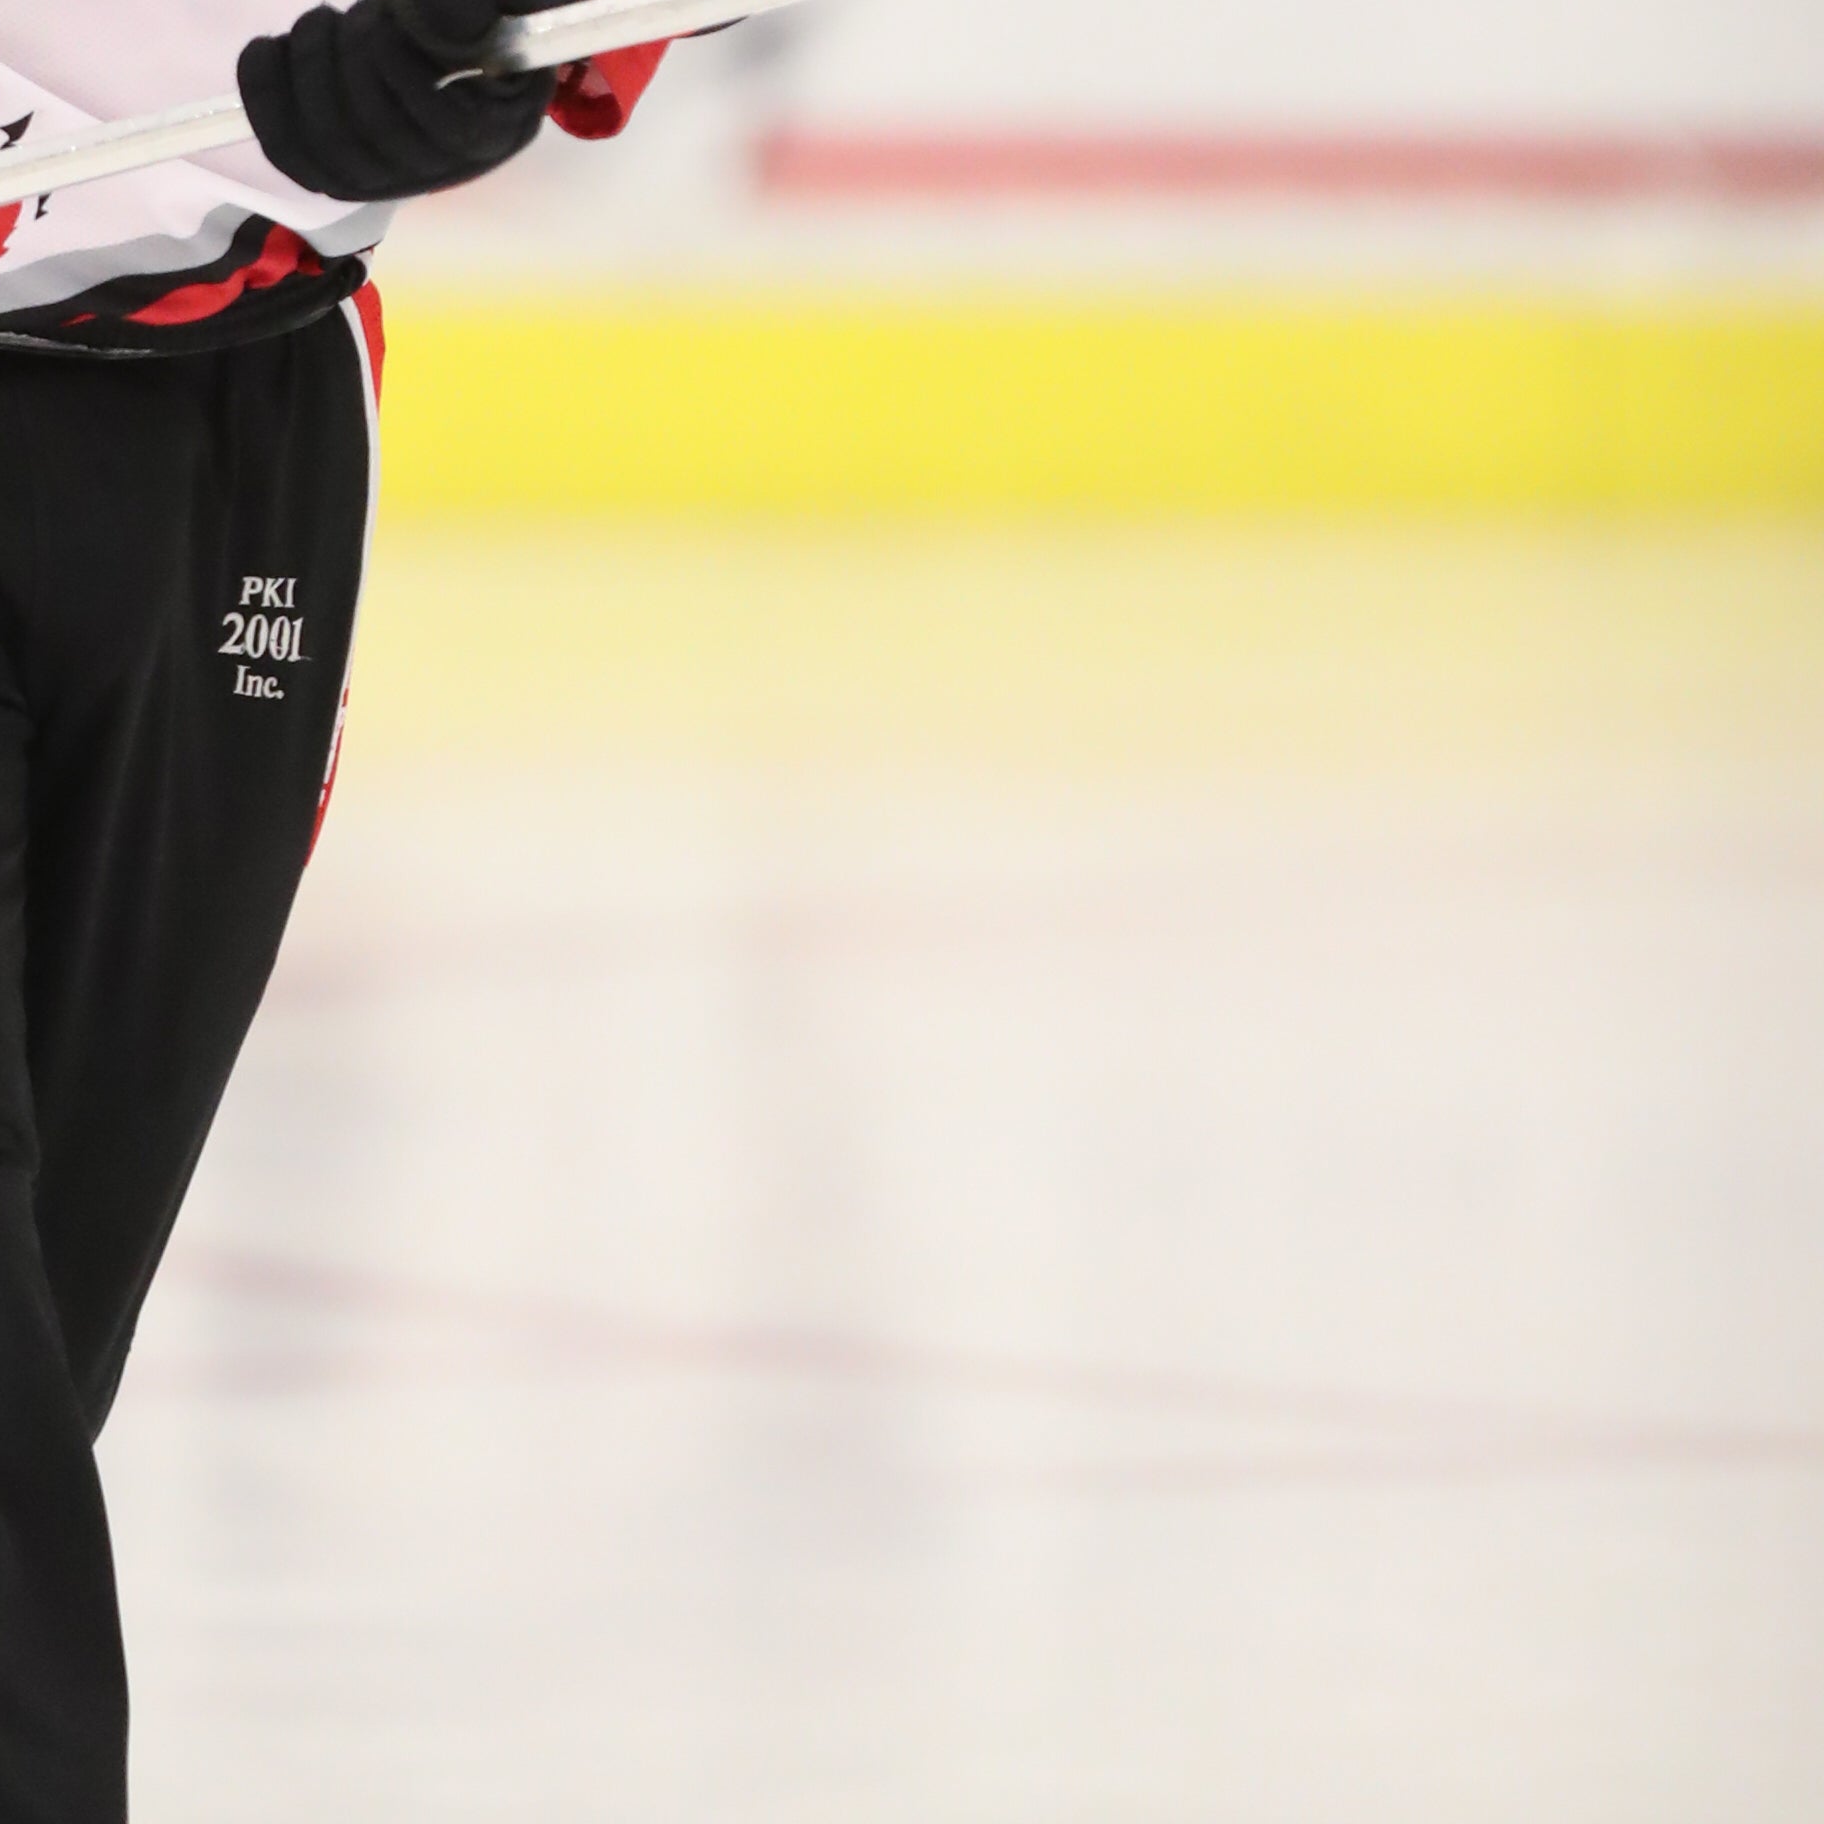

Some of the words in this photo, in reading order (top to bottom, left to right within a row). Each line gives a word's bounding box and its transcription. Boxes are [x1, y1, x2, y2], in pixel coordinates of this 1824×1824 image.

[238, 576, 297, 609] PKI
[217, 612, 305, 663] 2001
[233, 664, 285, 700] Inc.
